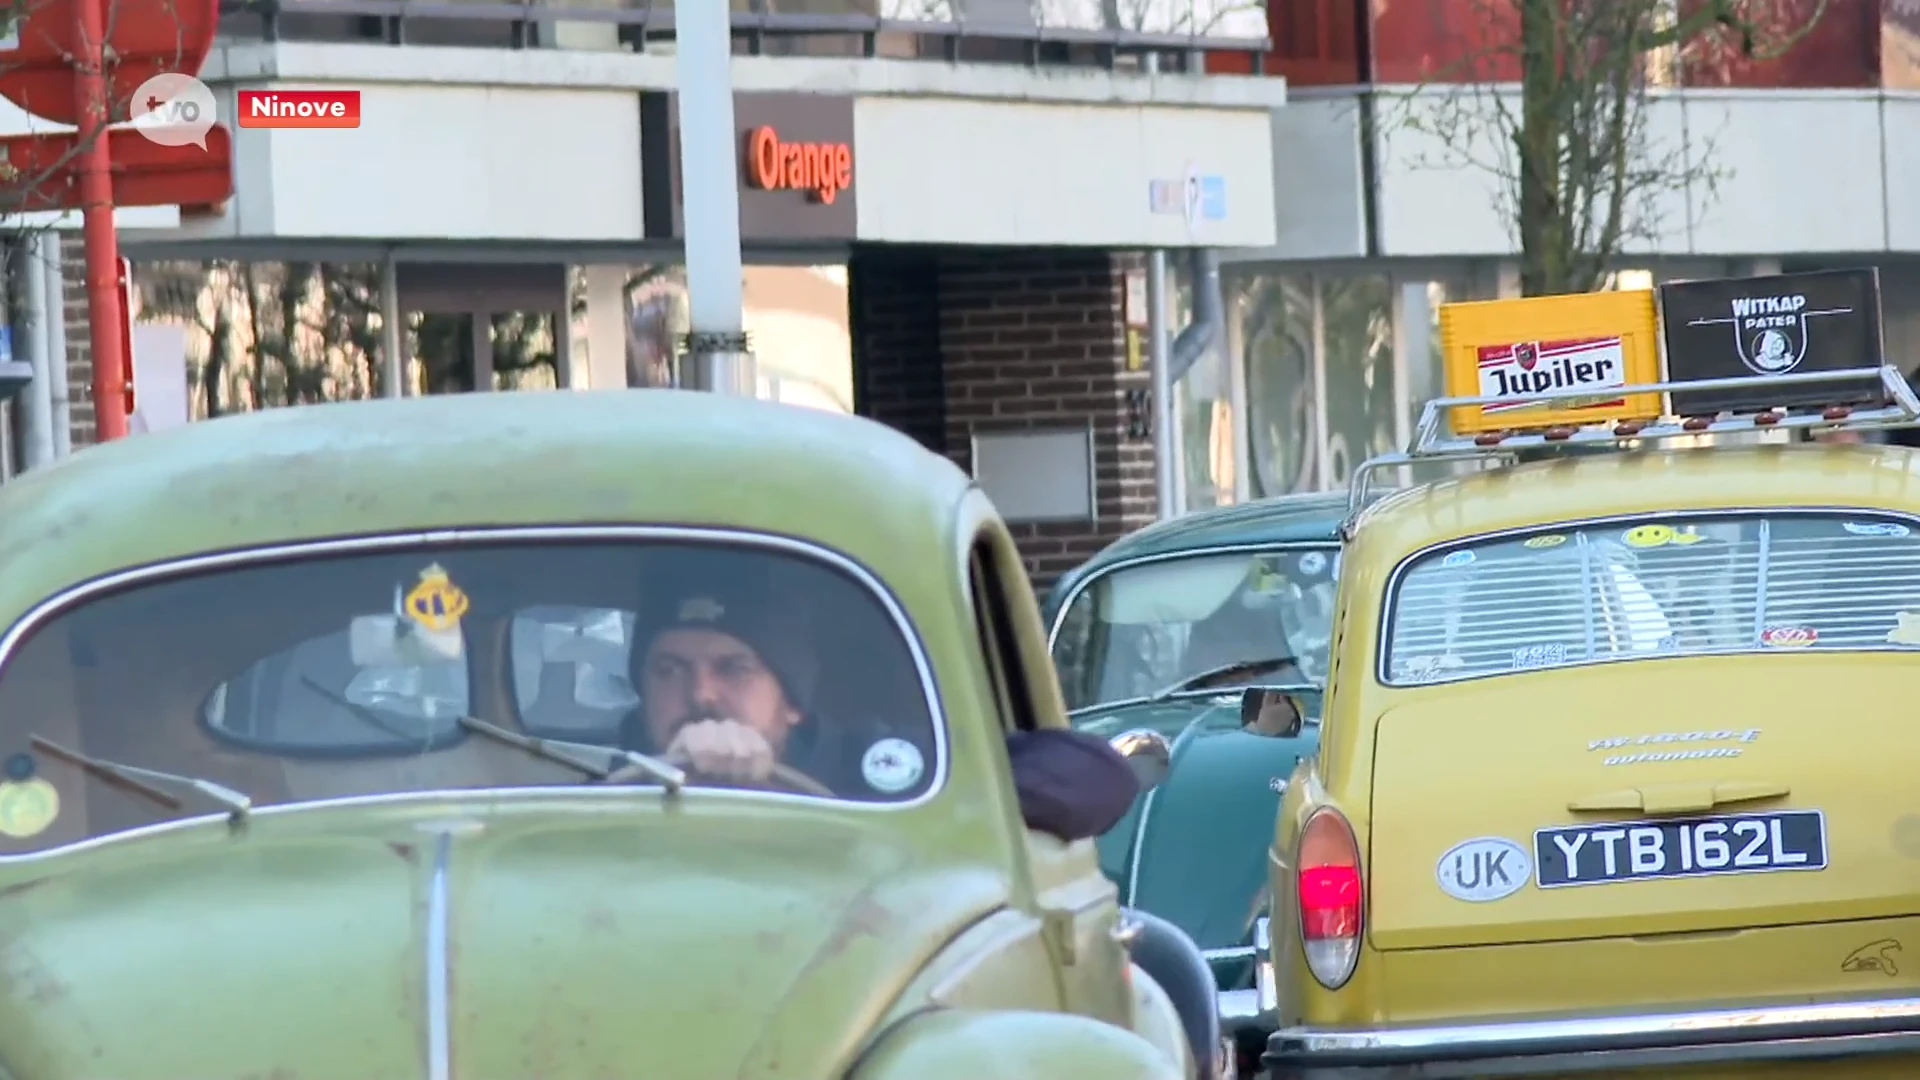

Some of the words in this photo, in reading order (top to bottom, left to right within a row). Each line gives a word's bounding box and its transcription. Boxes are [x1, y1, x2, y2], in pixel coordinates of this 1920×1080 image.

[754, 124, 851, 205] Orange
[1731, 294, 1806, 317] WITKAP
[1745, 314, 1797, 330] PATER
[1489, 358, 1613, 397] Jupiler
[1553, 826, 1666, 879] YTB
[1678, 818, 1807, 871] 162L
[1454, 848, 1511, 890] UK
